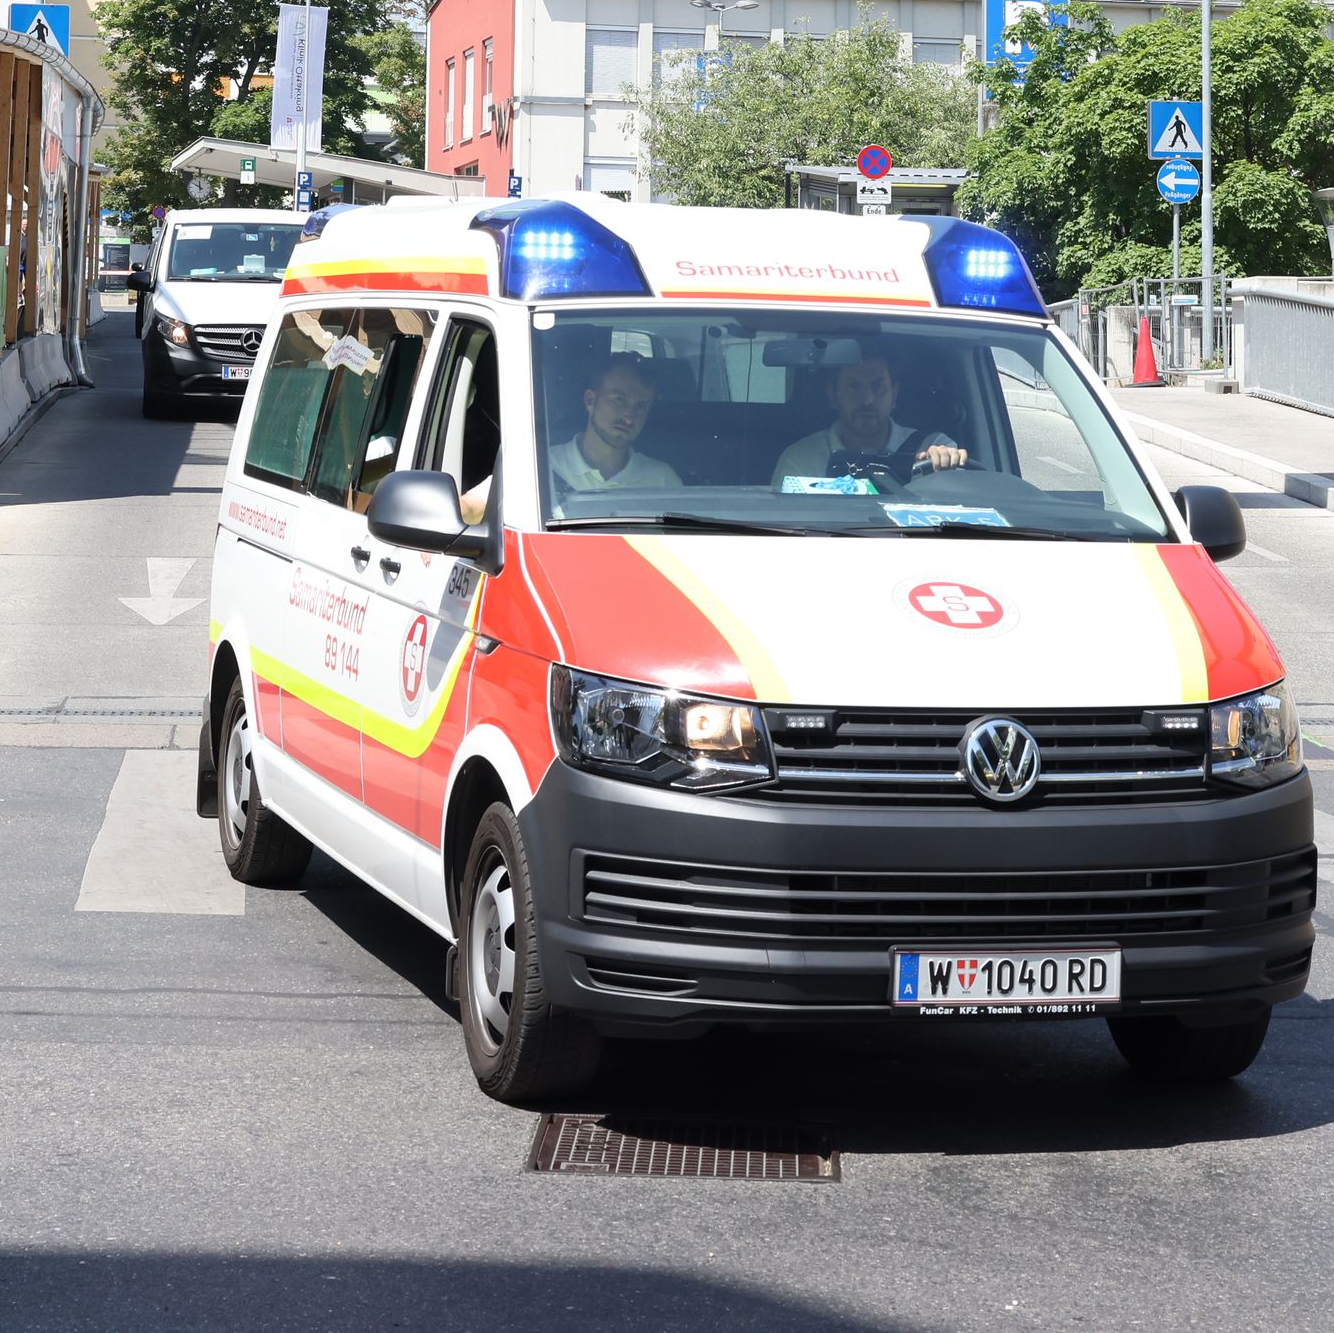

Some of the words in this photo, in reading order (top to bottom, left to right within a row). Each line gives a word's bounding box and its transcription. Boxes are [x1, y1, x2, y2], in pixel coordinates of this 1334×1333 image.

[1164, 191, 1192, 200] Fußgänger
[867, 207, 882, 215] Ende
[674, 259, 902, 285] Samariterbund
[448, 565, 472, 599] 345
[288, 567, 369, 636] Samariterbund
[324, 633, 338, 670] 89
[340, 643, 361, 683] 144
[903, 983, 913, 995] A
[928, 959, 953, 996] W
[980, 958, 1059, 995] 1040
[1067, 958, 1108, 994] RD
[919, 1006, 955, 1015] FunCar
[959, 1006, 979, 1015] KFZ
[986, 1005, 1023, 1015] Technik
[1036, 1004, 1069, 1014] 01/892
[1071, 1004, 1083, 1014] 11
[1085, 1004, 1097, 1013] 11
